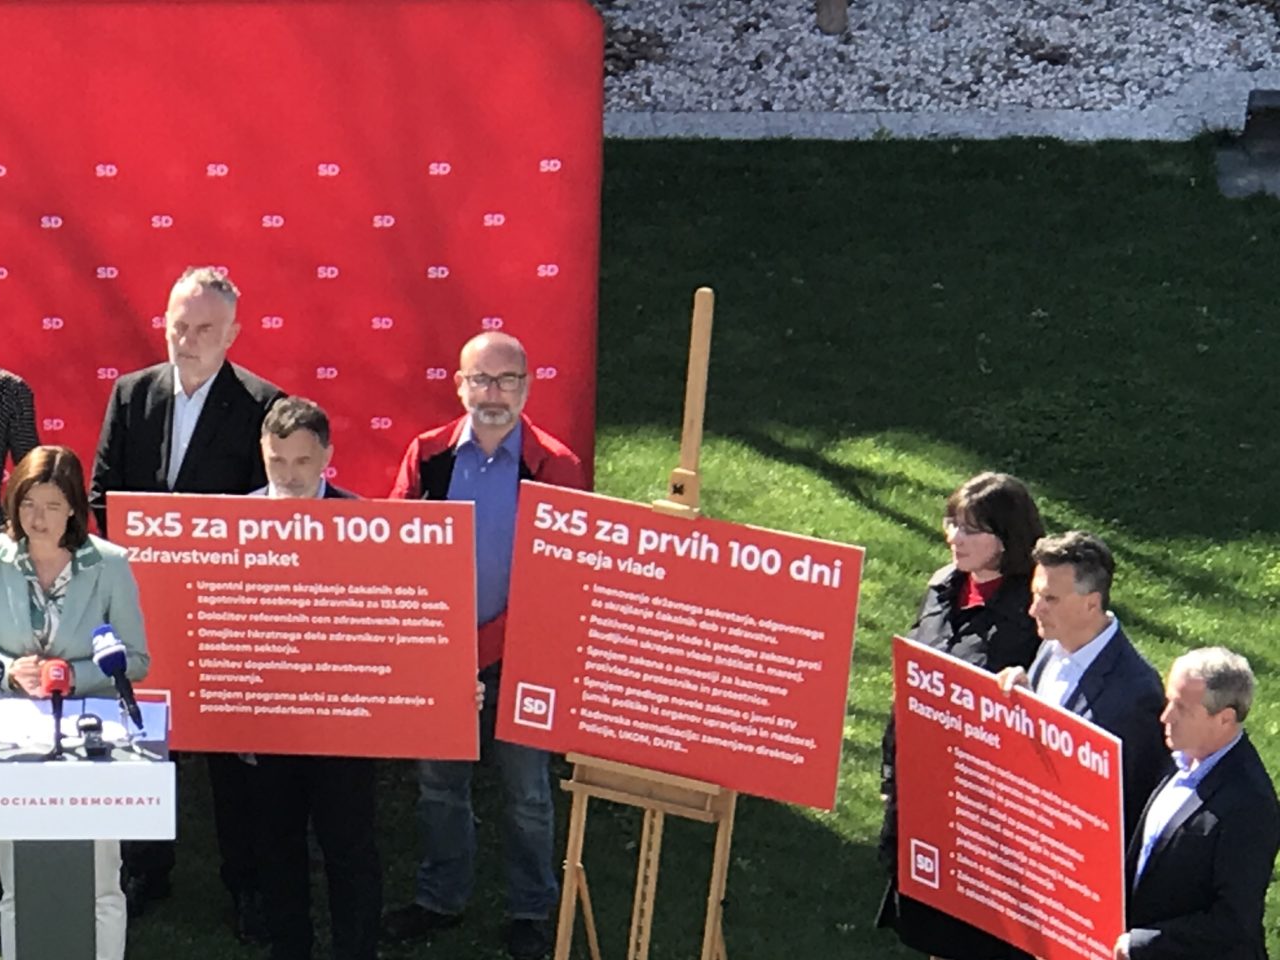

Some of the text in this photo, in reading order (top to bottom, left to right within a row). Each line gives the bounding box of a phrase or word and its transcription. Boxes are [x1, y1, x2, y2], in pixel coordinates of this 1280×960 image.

[96, 164, 117, 177] SD
[207, 164, 228, 176] SD
[318, 164, 339, 176] SD
[429, 163, 451, 175] SD
[540, 159, 561, 172] SD
[41, 216, 62, 228] SD
[152, 216, 173, 227] SD
[262, 216, 284, 227] SD
[373, 216, 395, 228] SD
[484, 214, 505, 226] SD
[97, 267, 118, 278] SD
[318, 267, 338, 278] SD
[428, 267, 449, 278] SD
[537, 264, 558, 277] SD
[43, 318, 63, 329] SD
[262, 317, 283, 328] SD
[372, 318, 392, 329] SD
[482, 318, 503, 329] SD
[97, 368, 118, 379] SD
[317, 368, 337, 379] SD
[427, 368, 446, 379] SD
[536, 368, 556, 379] SD
[43, 419, 64, 430] SD
[371, 418, 392, 429] SD
[125, 511, 453, 544] 5x5 za prvih 100 dni
[534, 502, 841, 587] 5x5 za prvih 100 dni
[126, 546, 299, 568] Zdravstveni paket
[532, 538, 665, 579] Prva seja vlade
[522, 696, 547, 714] SD
[906, 660, 1109, 778] 5x5 za prvih 100 dni
[908, 696, 1000, 748] Razvojni paket
[69, 797, 161, 806] DEMOKRATI
